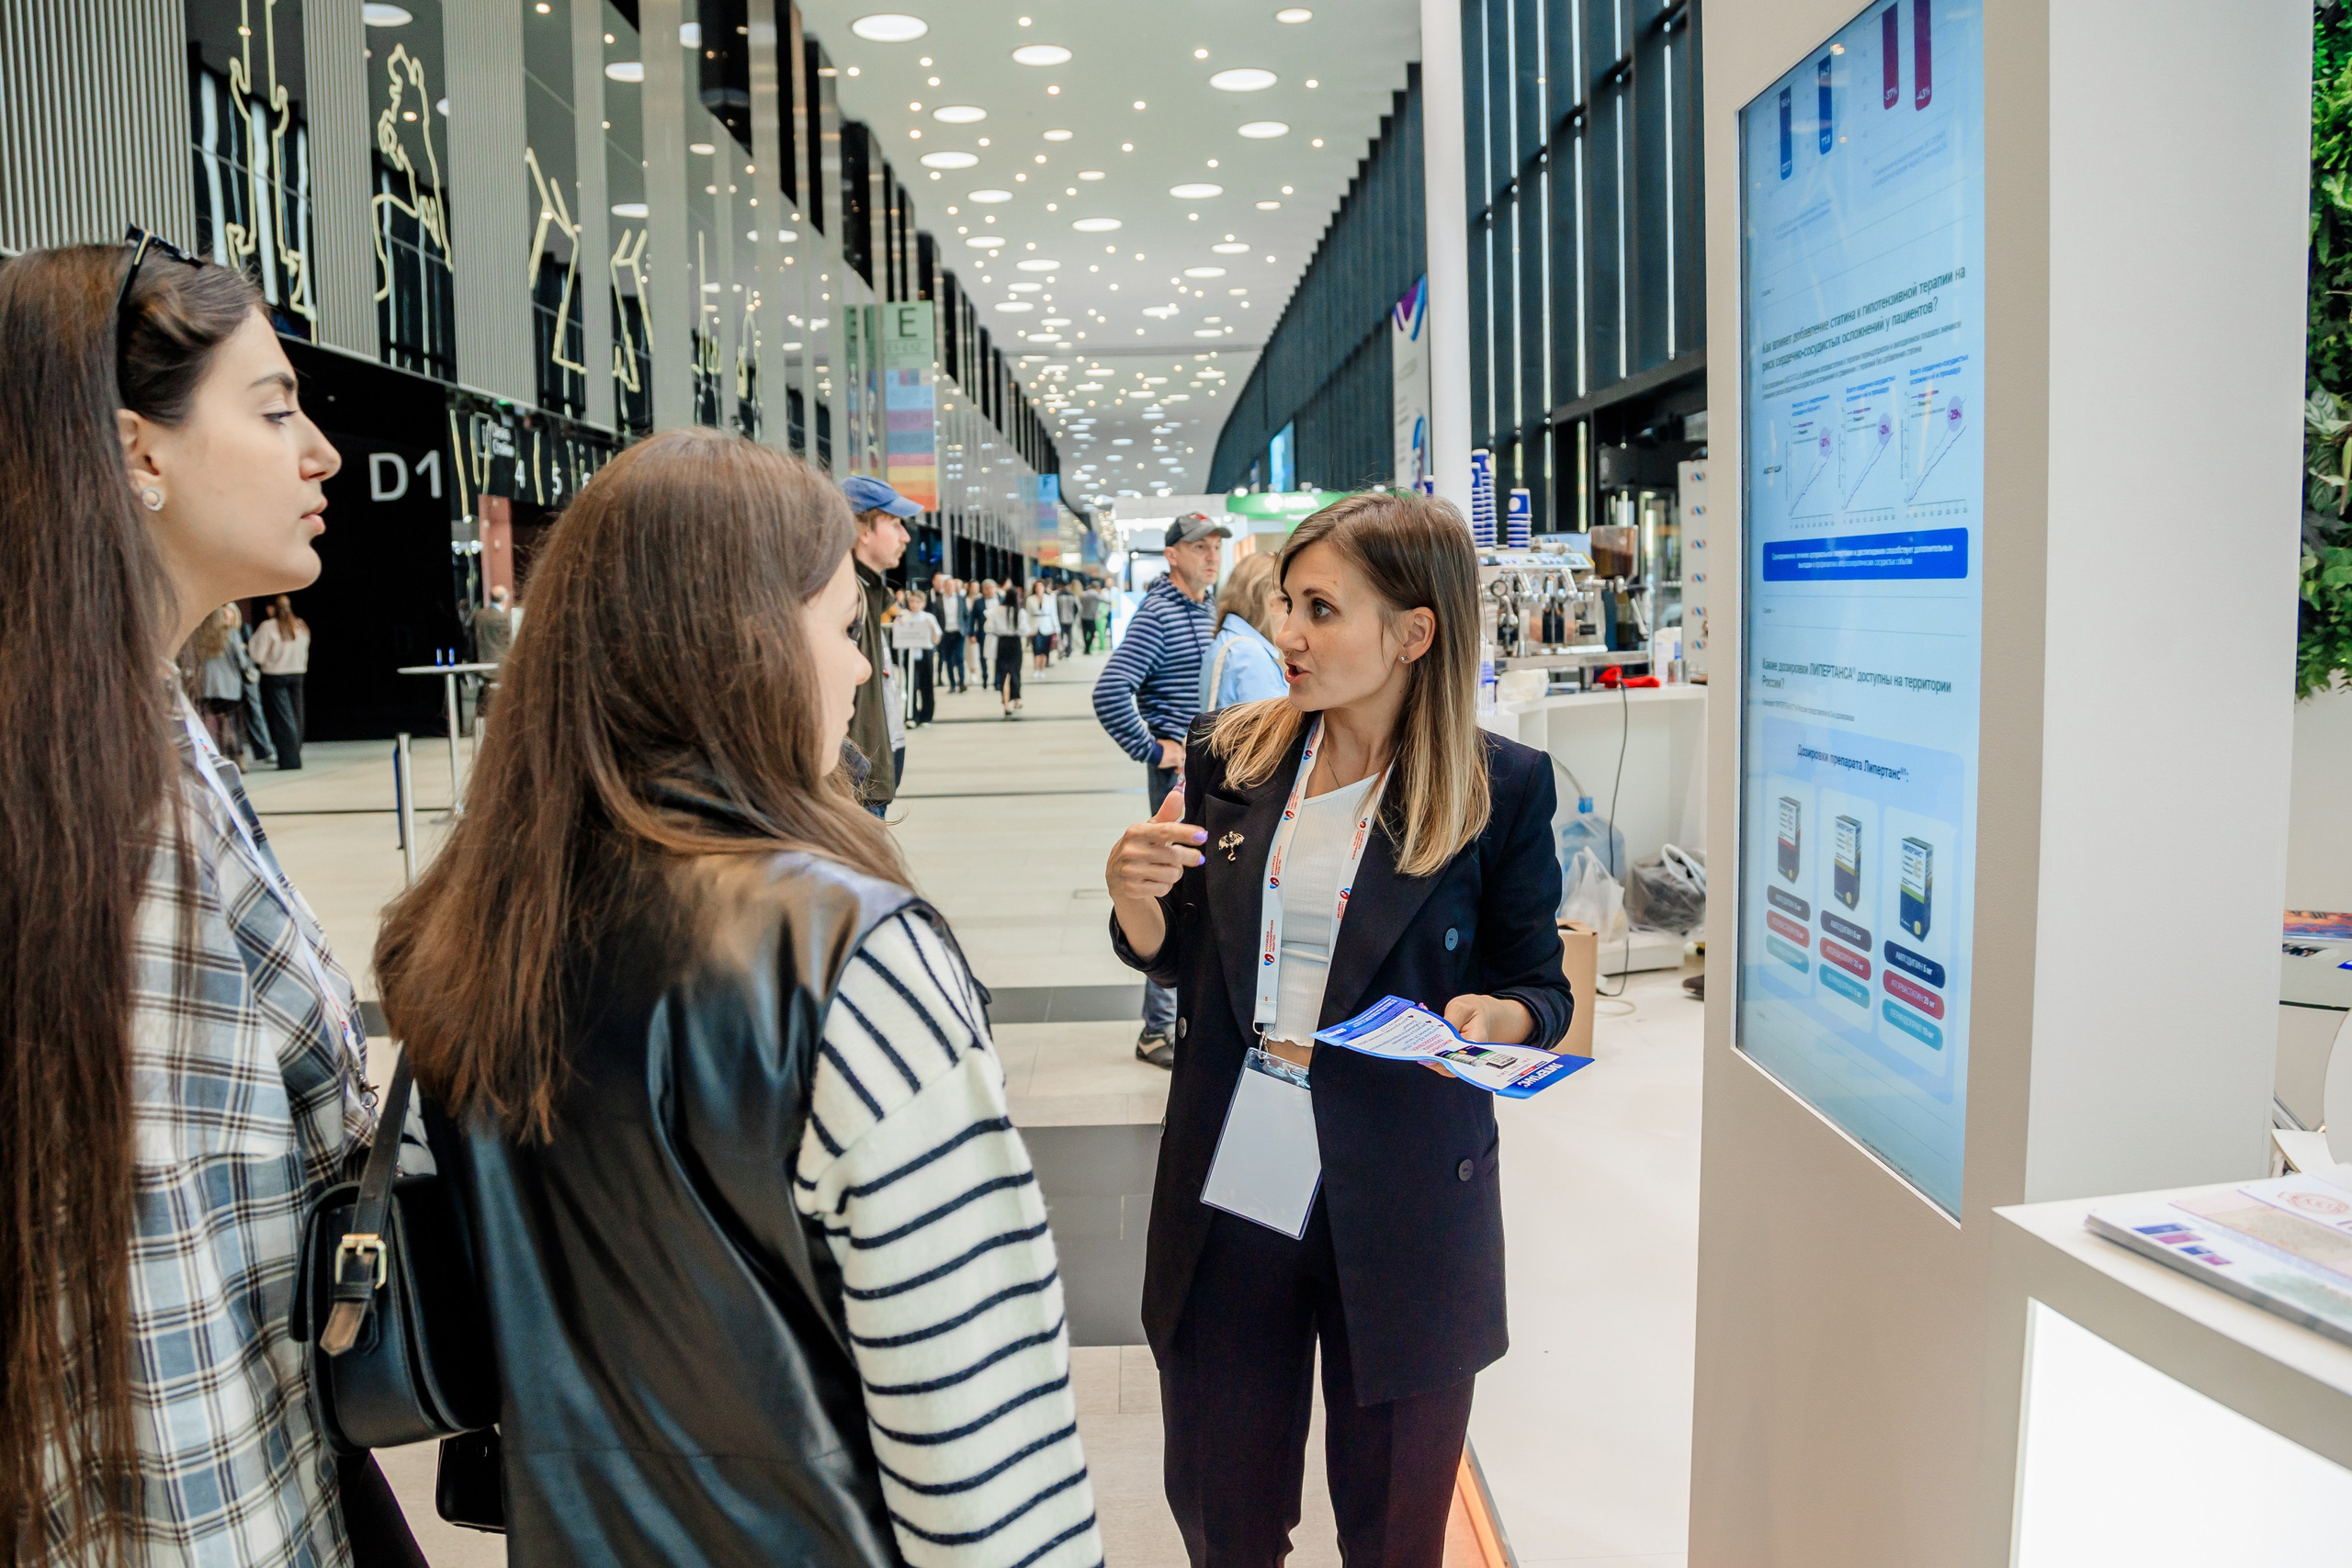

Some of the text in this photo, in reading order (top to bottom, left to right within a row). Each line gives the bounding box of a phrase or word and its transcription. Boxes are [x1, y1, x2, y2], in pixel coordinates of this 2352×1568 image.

[899, 307, 917, 337] E
[1762, 341, 1770, 354] Как
[1792, 316, 1828, 344] добавление
[1830, 310, 1855, 328] статина
[1857, 307, 1860, 318] к
[1862, 281, 1917, 316] гипотензивной
[1919, 270, 1952, 298] терапии
[1955, 265, 1965, 280] на
[1762, 295, 1938, 374] риск сердечно-сосудистых осложнений у пациентов?
[369, 449, 443, 502] D1
[514, 459, 526, 490] 4
[552, 467, 563, 496] 5
[1762, 658, 1777, 671] Какие
[1778, 661, 1808, 677] дозировки
[1857, 671, 1892, 689] доступны
[1894, 675, 1902, 686] на
[1905, 676, 1951, 697] территории
[1762, 674, 1784, 689] России?
[1797, 743, 1828, 765] Дозировки
[1829, 753, 1861, 773] препарата
